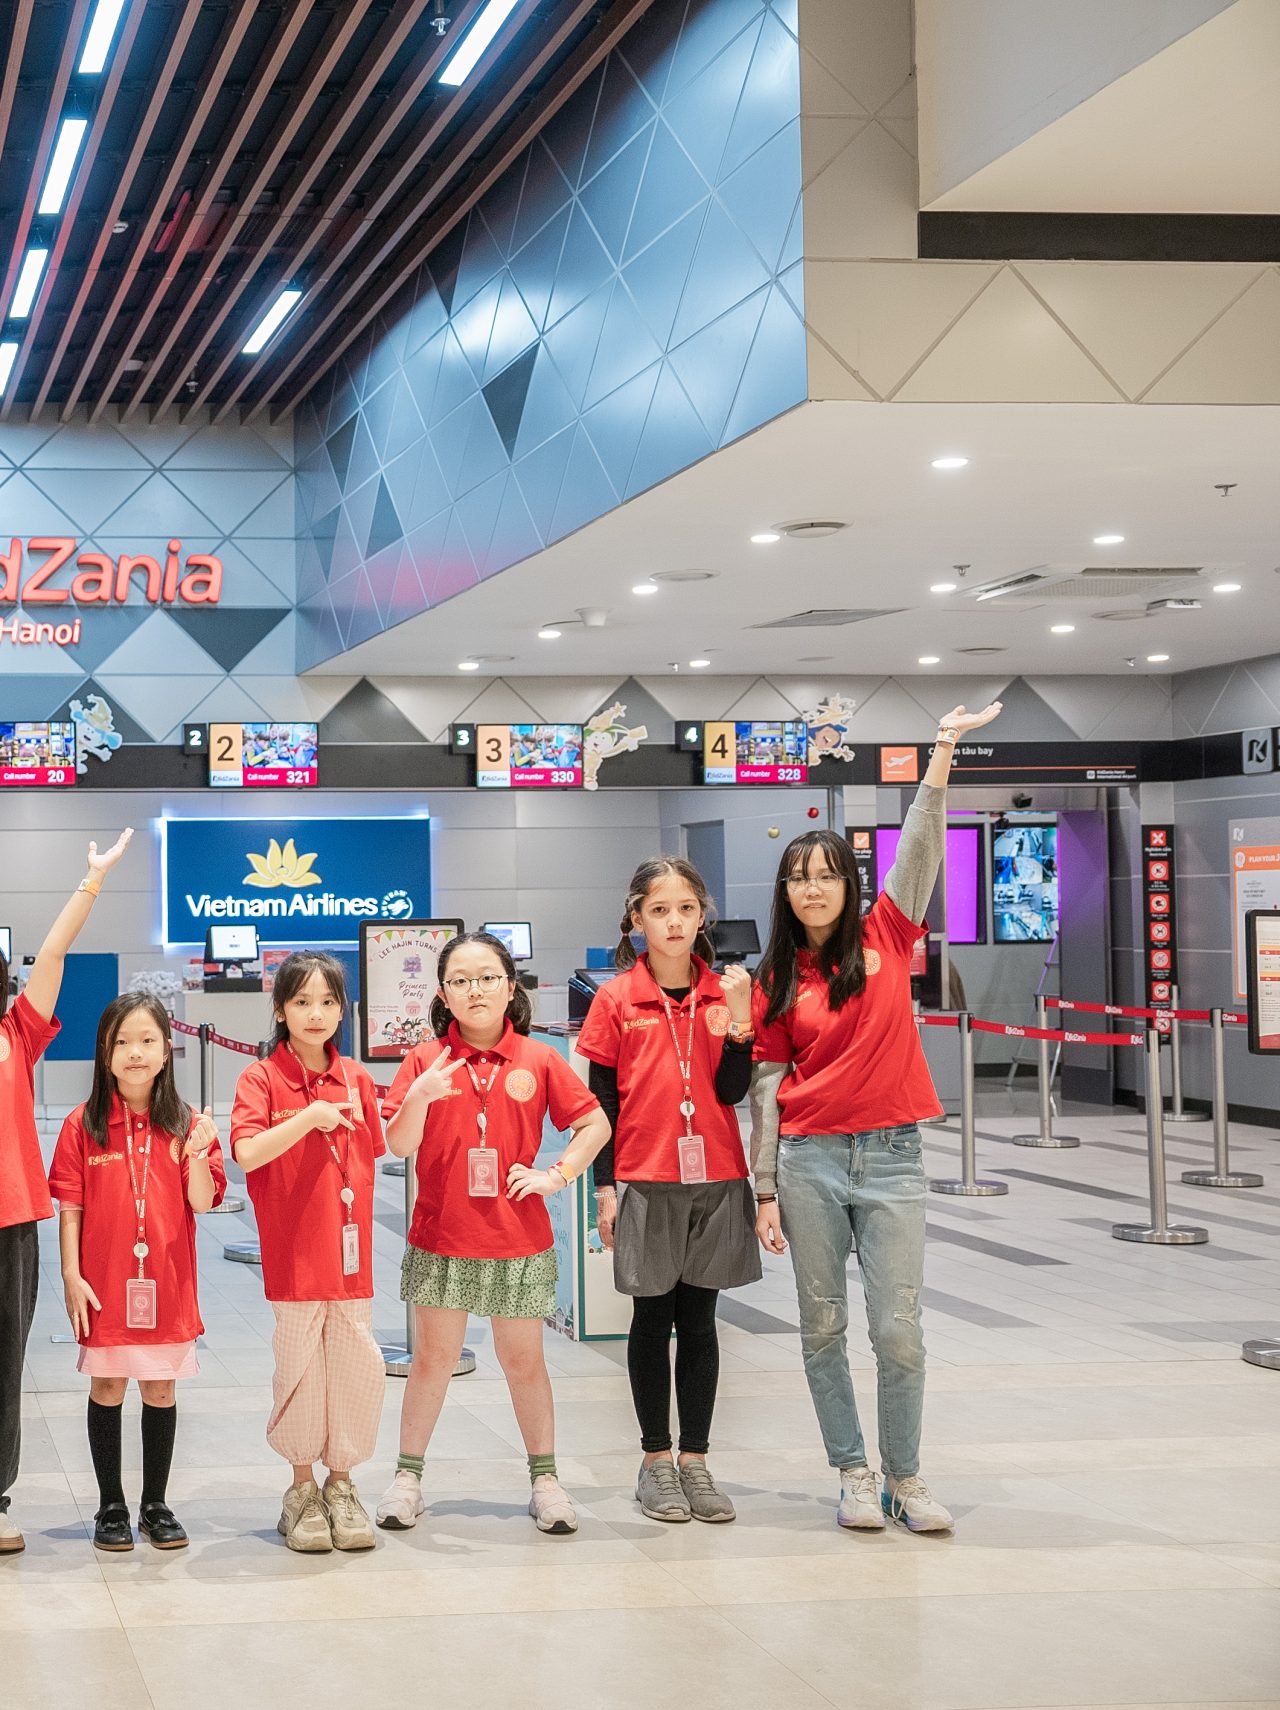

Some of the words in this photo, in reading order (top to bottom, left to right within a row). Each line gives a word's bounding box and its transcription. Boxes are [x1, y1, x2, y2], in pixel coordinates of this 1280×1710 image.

[189, 730, 202, 746] 2
[456, 730, 470, 746] 3
[684, 726, 699, 743] 4
[216, 735, 235, 762] 2
[485, 737, 502, 762] 3
[710, 733, 729, 759] 4
[962, 746, 977, 755] tàu
[978, 746, 993, 757] bay
[3, 772, 14, 780] Call
[47, 770, 65, 783] 20
[286, 770, 310, 783] 321
[550, 770, 575, 783] 330
[777, 768, 801, 780] 328
[186, 895, 288, 917] Vietnam
[288, 893, 378, 917] Airlines
[378, 947, 391, 960] LEE
[391, 940, 413, 950] HAJIN
[415, 940, 438, 953] TURNS
[398, 981, 428, 990] Princess
[402, 988, 424, 999] Party
